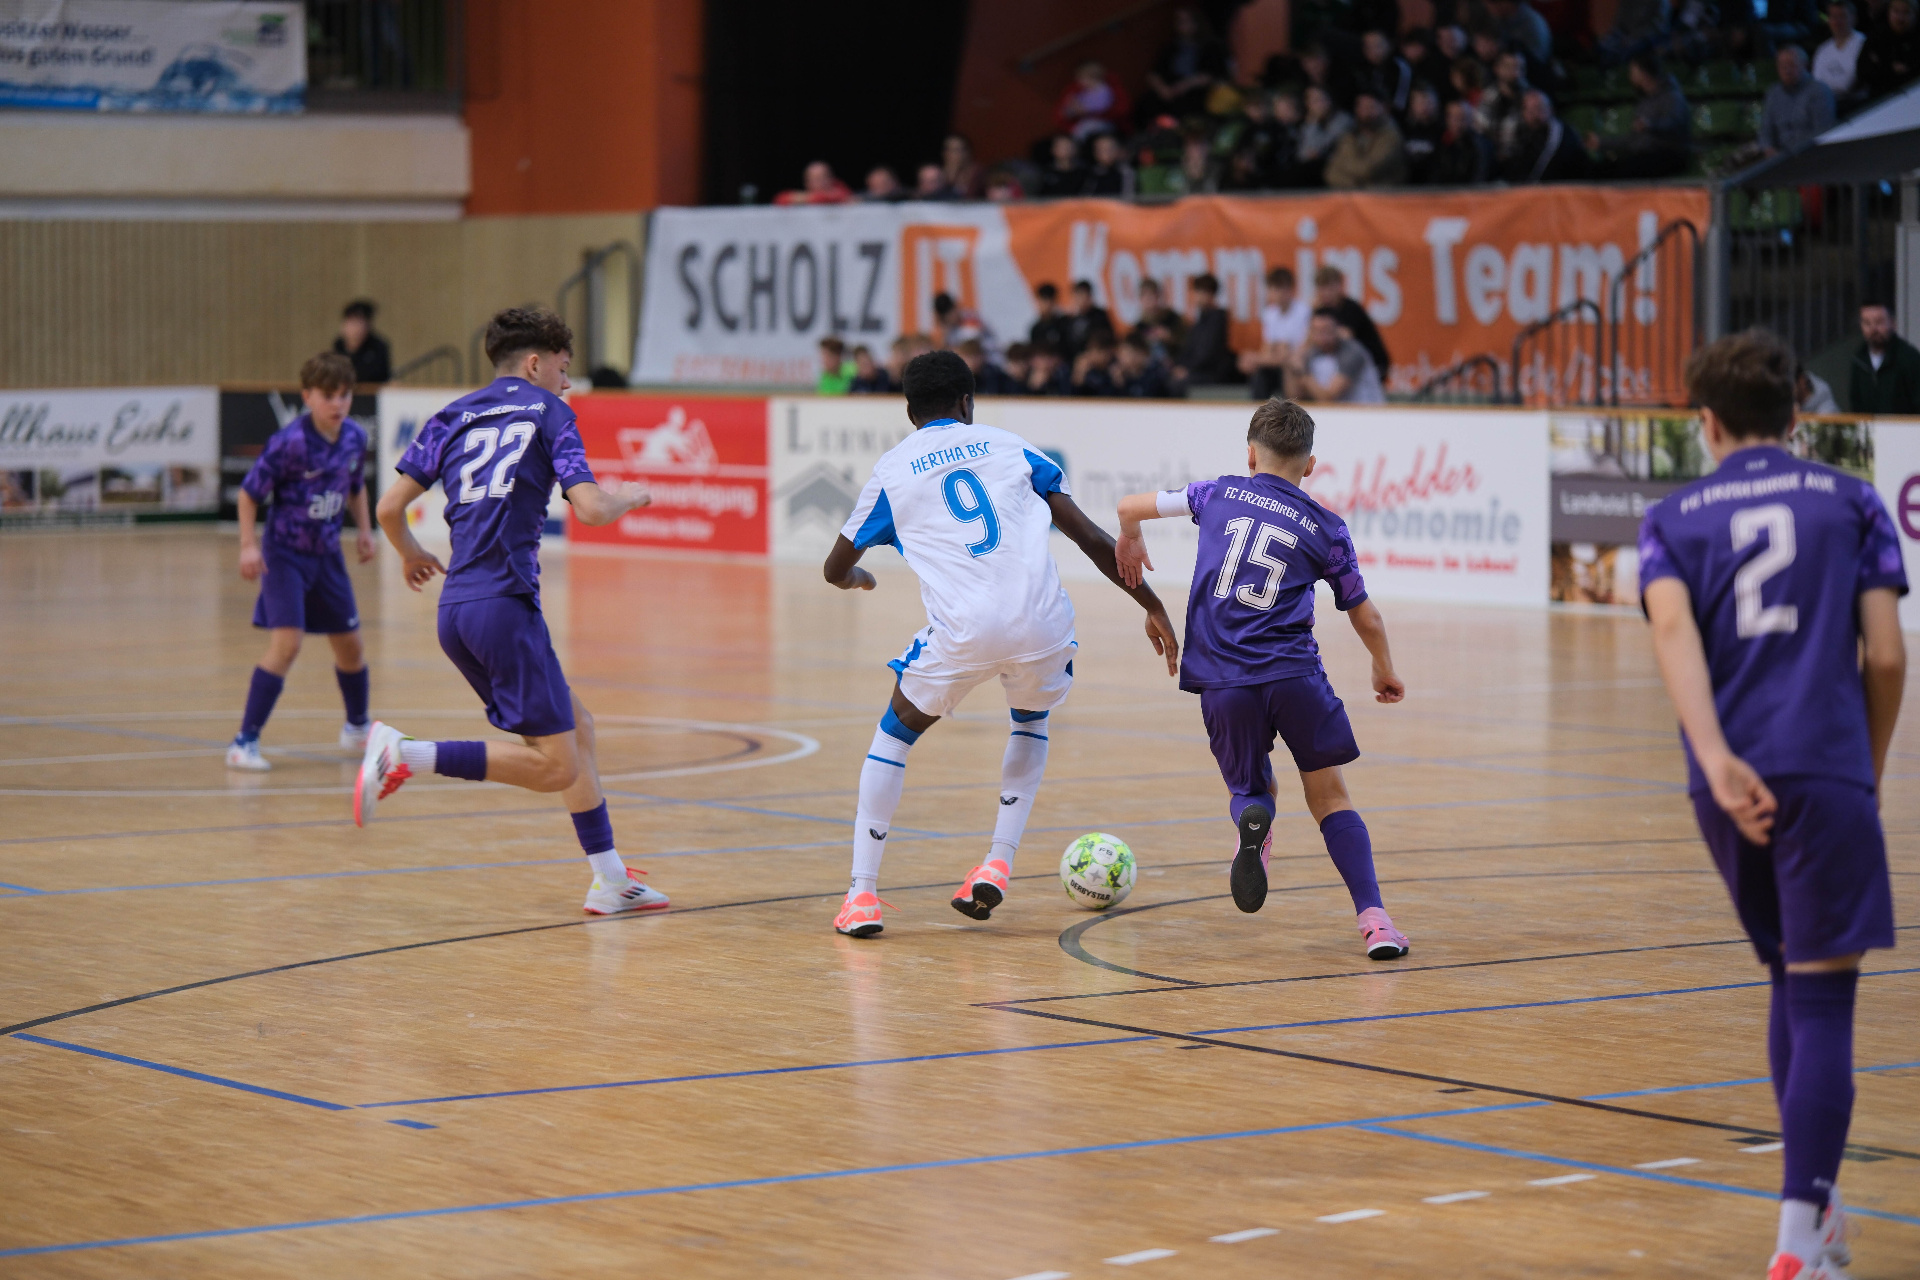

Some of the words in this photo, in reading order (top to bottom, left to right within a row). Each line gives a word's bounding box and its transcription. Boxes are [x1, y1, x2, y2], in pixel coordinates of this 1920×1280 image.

[677, 240, 891, 334] SCHOLZ
[1068, 221, 1266, 325] Komm
[1296, 215, 1403, 327] ins
[1424, 210, 1658, 327] Team!
[459, 421, 537, 505] 22
[910, 446, 967, 476] HERTHA
[965, 441, 994, 458] BSC
[940, 467, 1001, 559] 9
[1224, 486, 1239, 500] FC
[1238, 489, 1300, 522] ERZGEBIRGE
[1299, 515, 1319, 536] AUE
[1350, 496, 1522, 545] tronomie
[1213, 516, 1299, 611] 15
[1730, 502, 1799, 640] 2
[1070, 879, 1111, 901] DERBYSTAR
